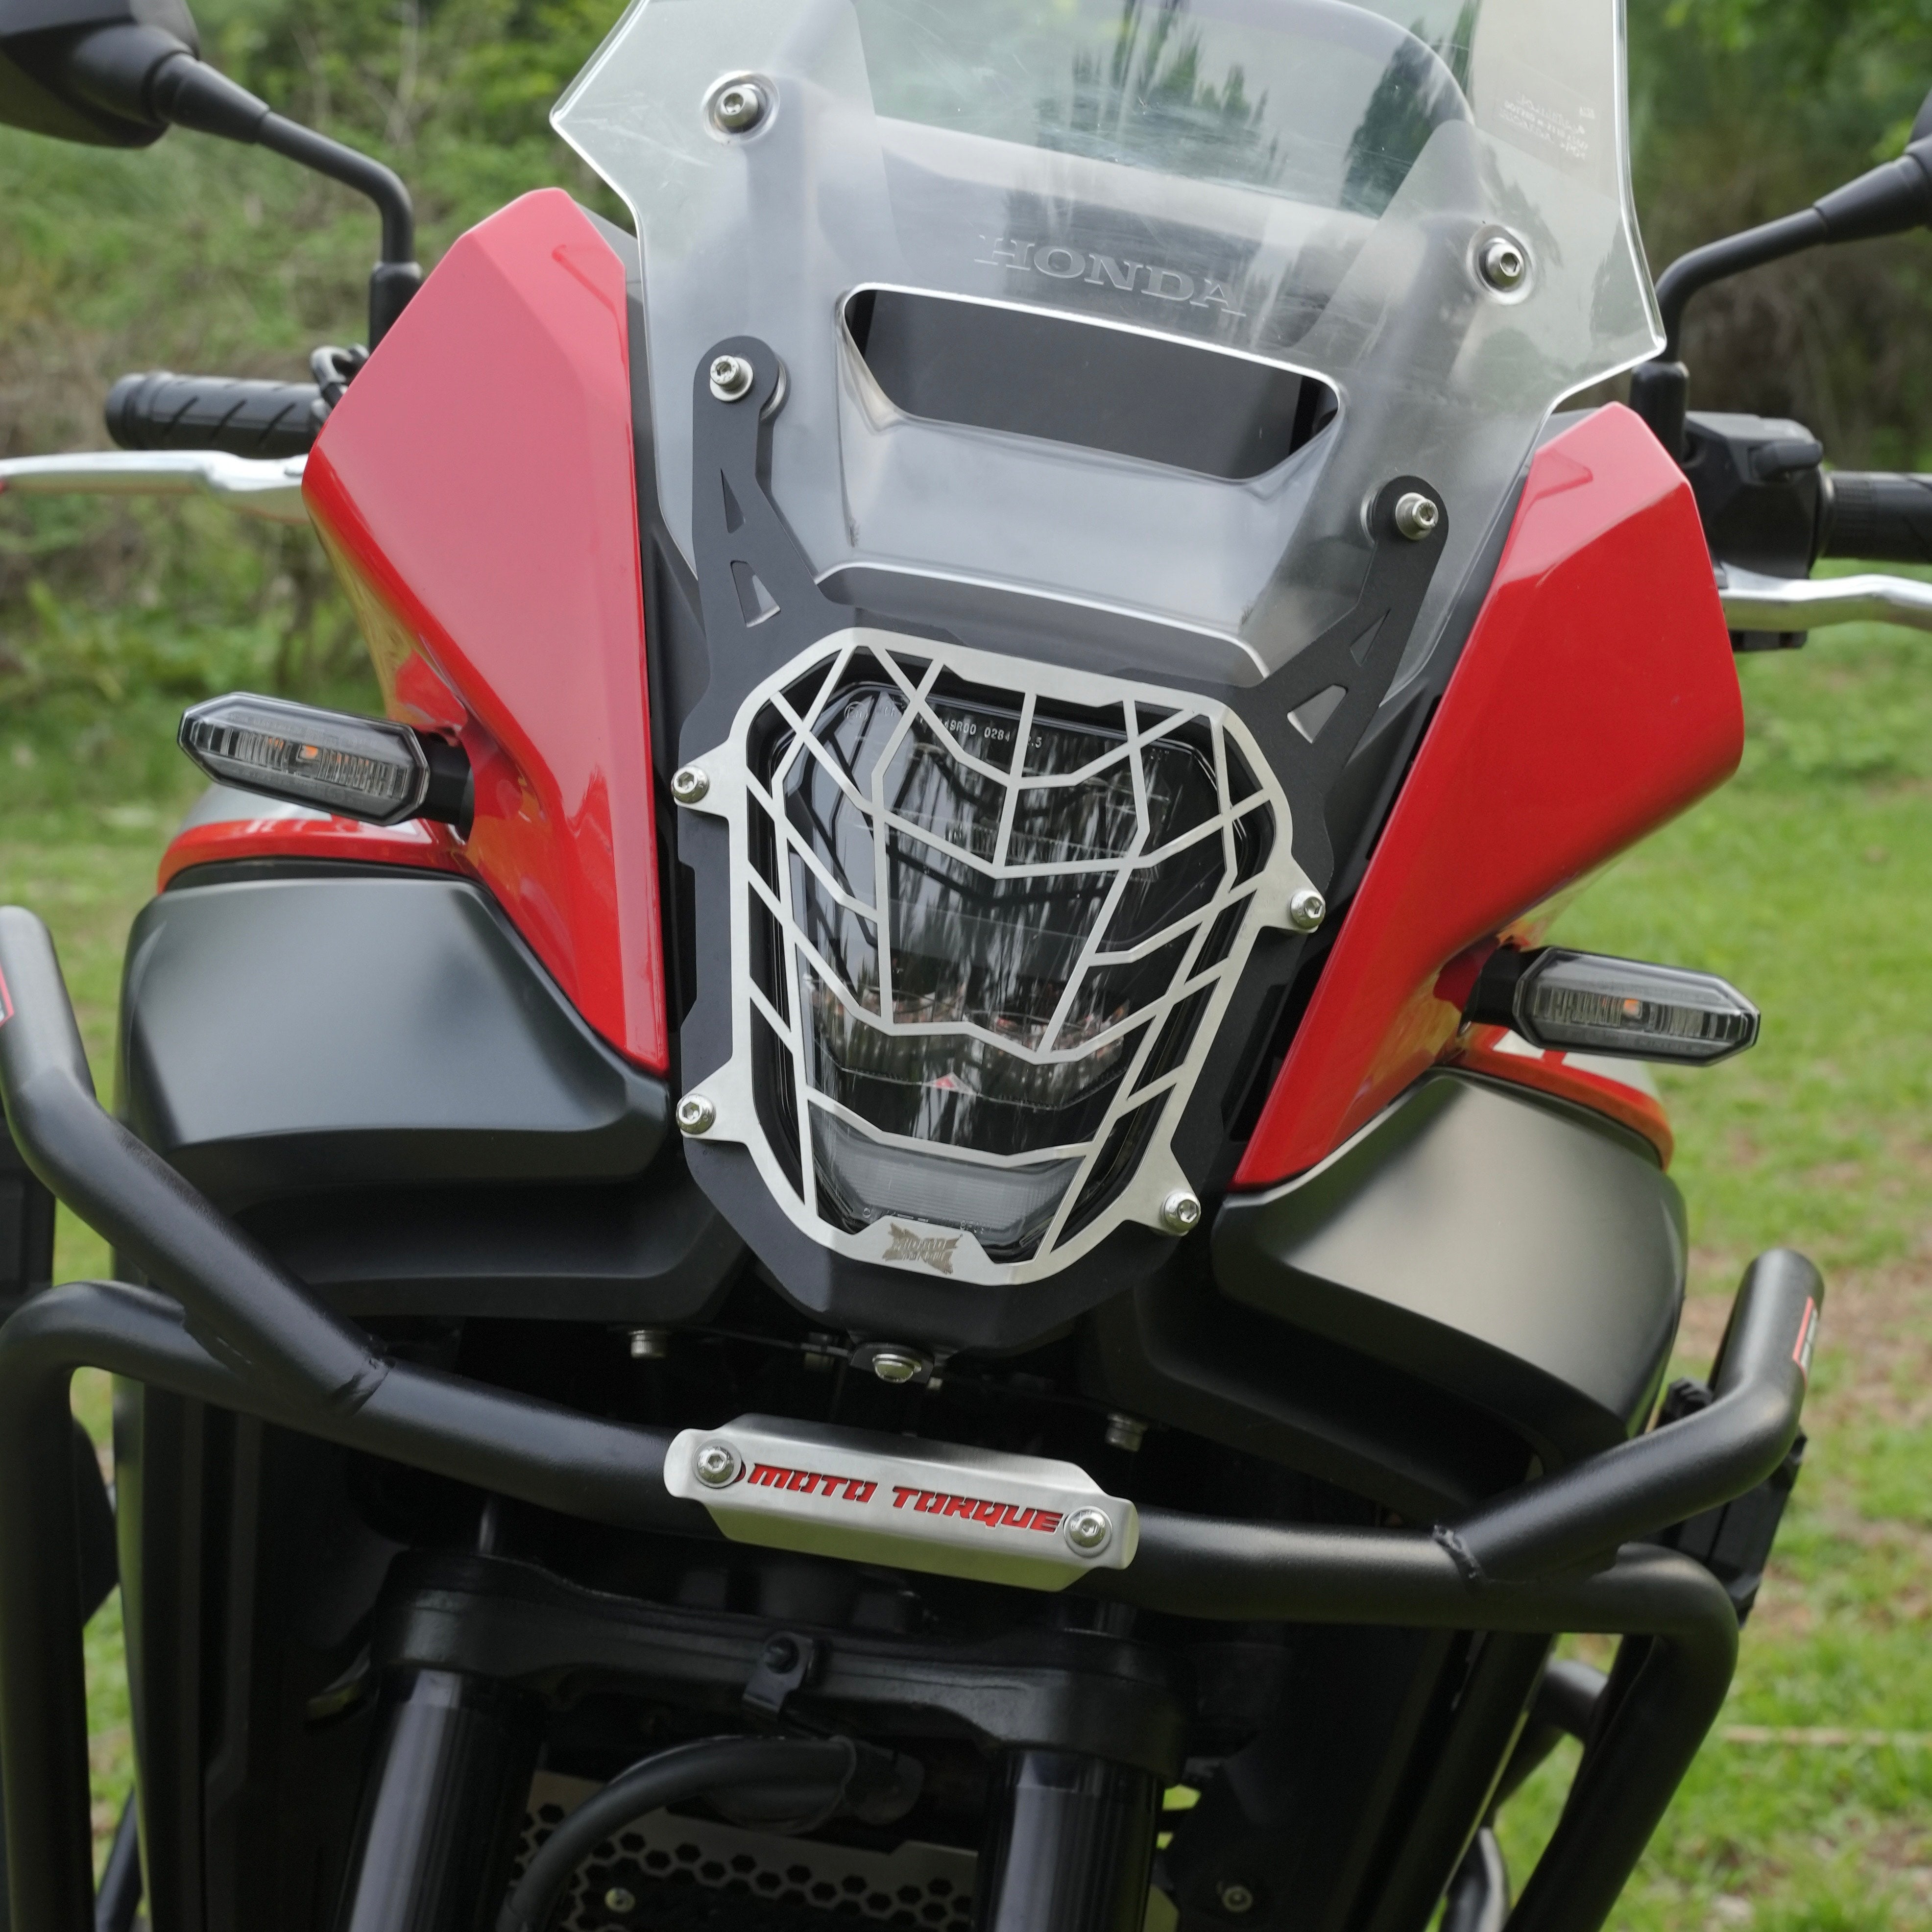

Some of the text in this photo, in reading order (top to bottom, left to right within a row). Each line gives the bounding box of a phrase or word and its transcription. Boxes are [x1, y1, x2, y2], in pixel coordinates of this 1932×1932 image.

[974, 234, 1246, 317] HONDA
[748, 1463, 1064, 1535] MOTO TORQUE
